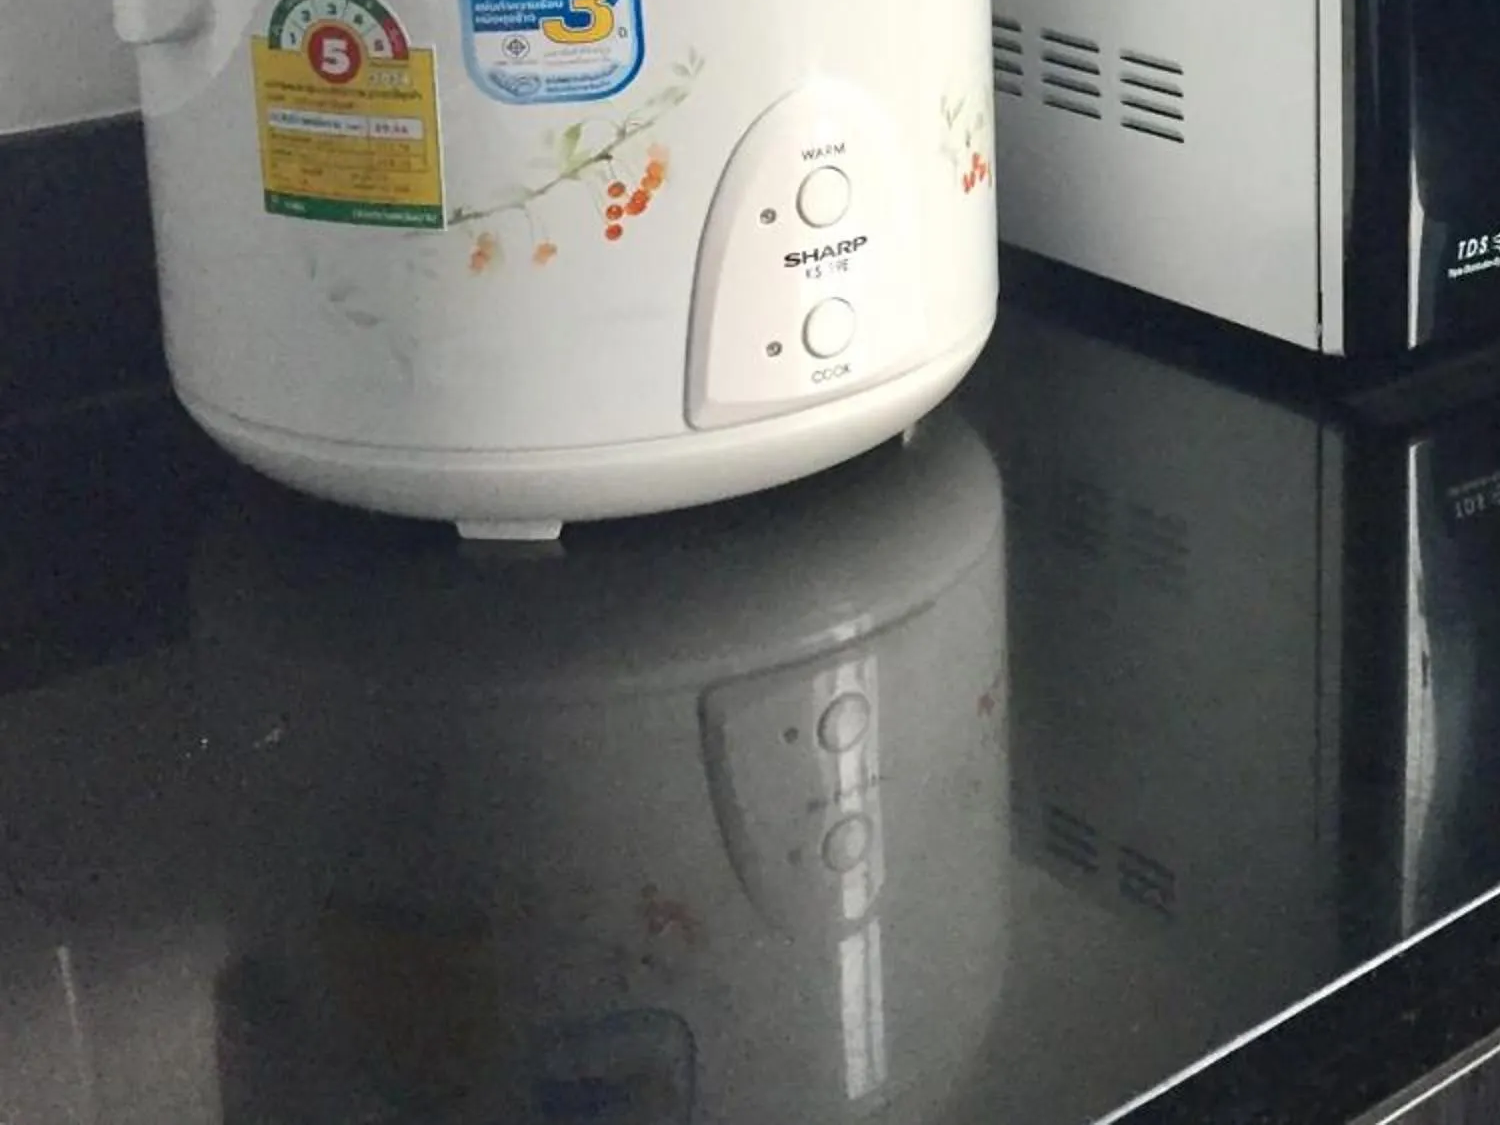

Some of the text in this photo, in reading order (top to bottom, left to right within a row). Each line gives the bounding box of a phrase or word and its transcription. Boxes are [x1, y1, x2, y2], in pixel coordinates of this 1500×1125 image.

[320, 37, 350, 75] 5
[801, 142, 846, 161] WARM
[784, 235, 868, 268] SHARP
[1458, 235, 1489, 260] TDS
